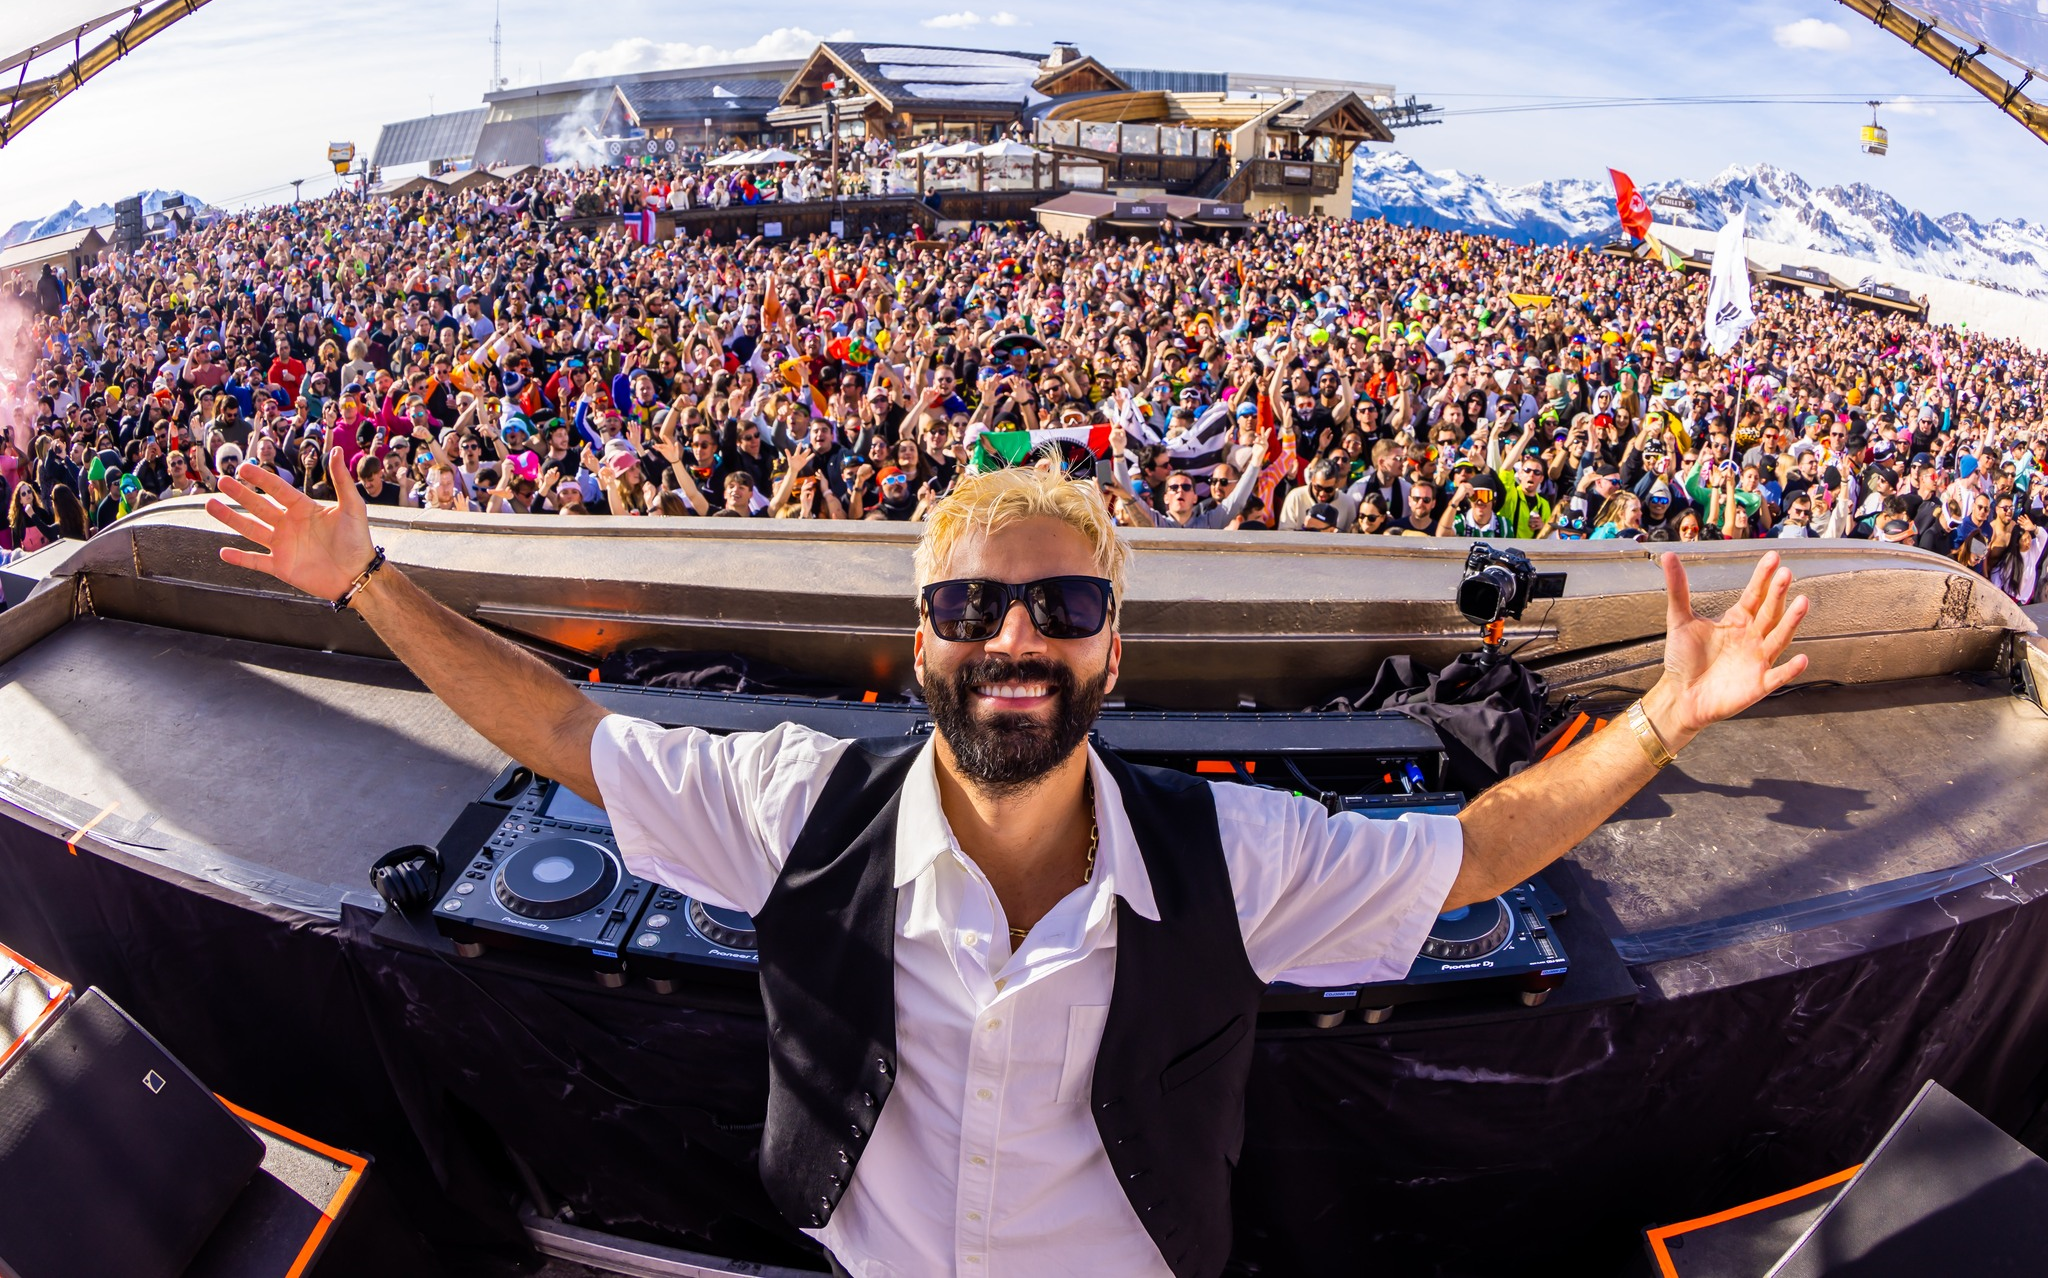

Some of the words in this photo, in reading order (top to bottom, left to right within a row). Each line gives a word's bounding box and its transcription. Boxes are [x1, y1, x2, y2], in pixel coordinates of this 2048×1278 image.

[1660, 197, 1686, 208] TOILETS
[1795, 269, 1814, 280] DRINKS
[1876, 286, 1895, 297] DRINKS
[501, 916, 538, 928] Pioneer
[708, 949, 751, 959] Pioneer
[1441, 962, 1481, 971] Pioneer
